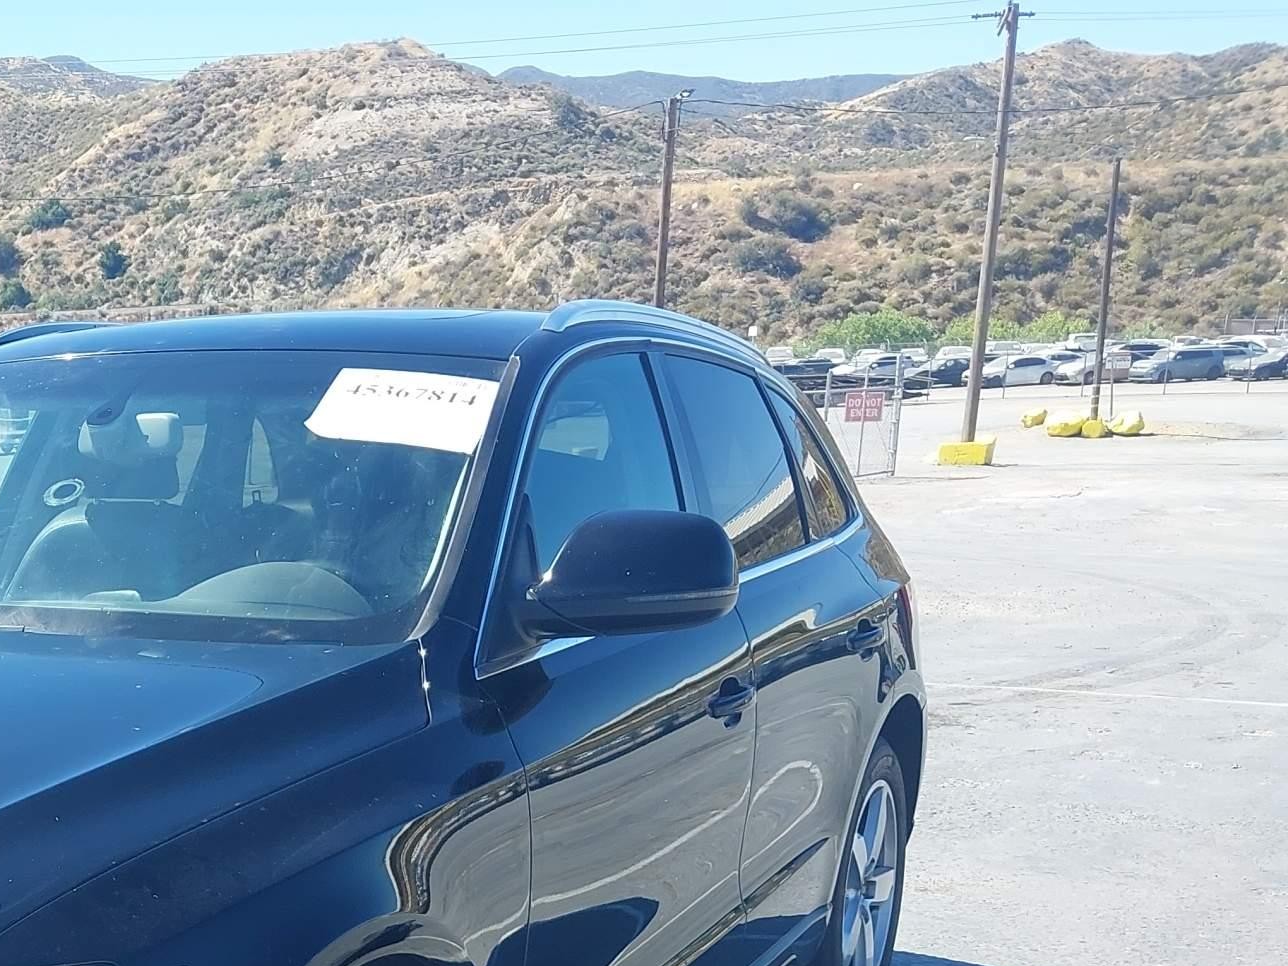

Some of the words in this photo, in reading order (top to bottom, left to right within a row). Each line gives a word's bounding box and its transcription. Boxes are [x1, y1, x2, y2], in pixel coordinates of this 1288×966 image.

[346, 383, 477, 406] 45367814
[848, 398, 861, 407] DO
[850, 408, 878, 417] ENER
